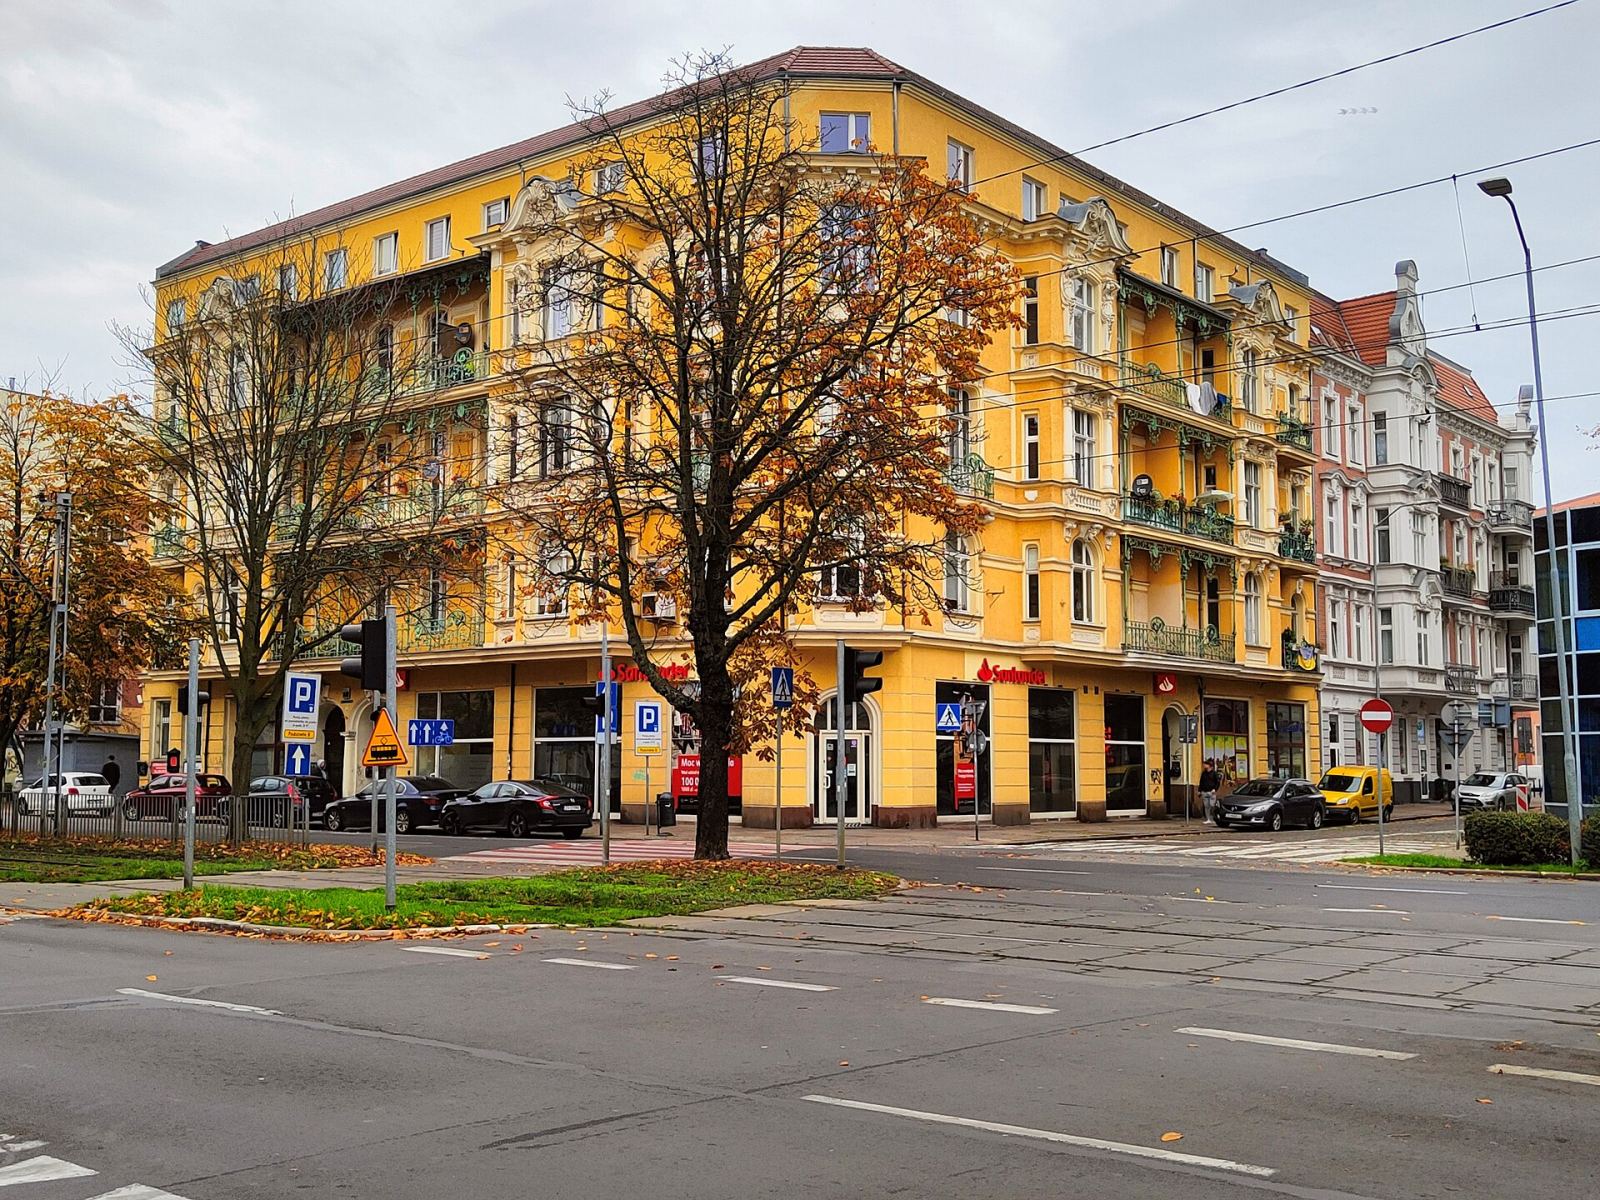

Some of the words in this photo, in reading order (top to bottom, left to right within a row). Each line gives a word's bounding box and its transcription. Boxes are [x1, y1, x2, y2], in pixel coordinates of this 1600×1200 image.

[617, 662, 689, 681] Sannder
[992, 665, 1048, 685] Santander
[295, 682, 311, 708] P
[643, 708, 655, 729] P
[680, 758, 695, 768] Moc
[681, 777, 694, 787] 100
